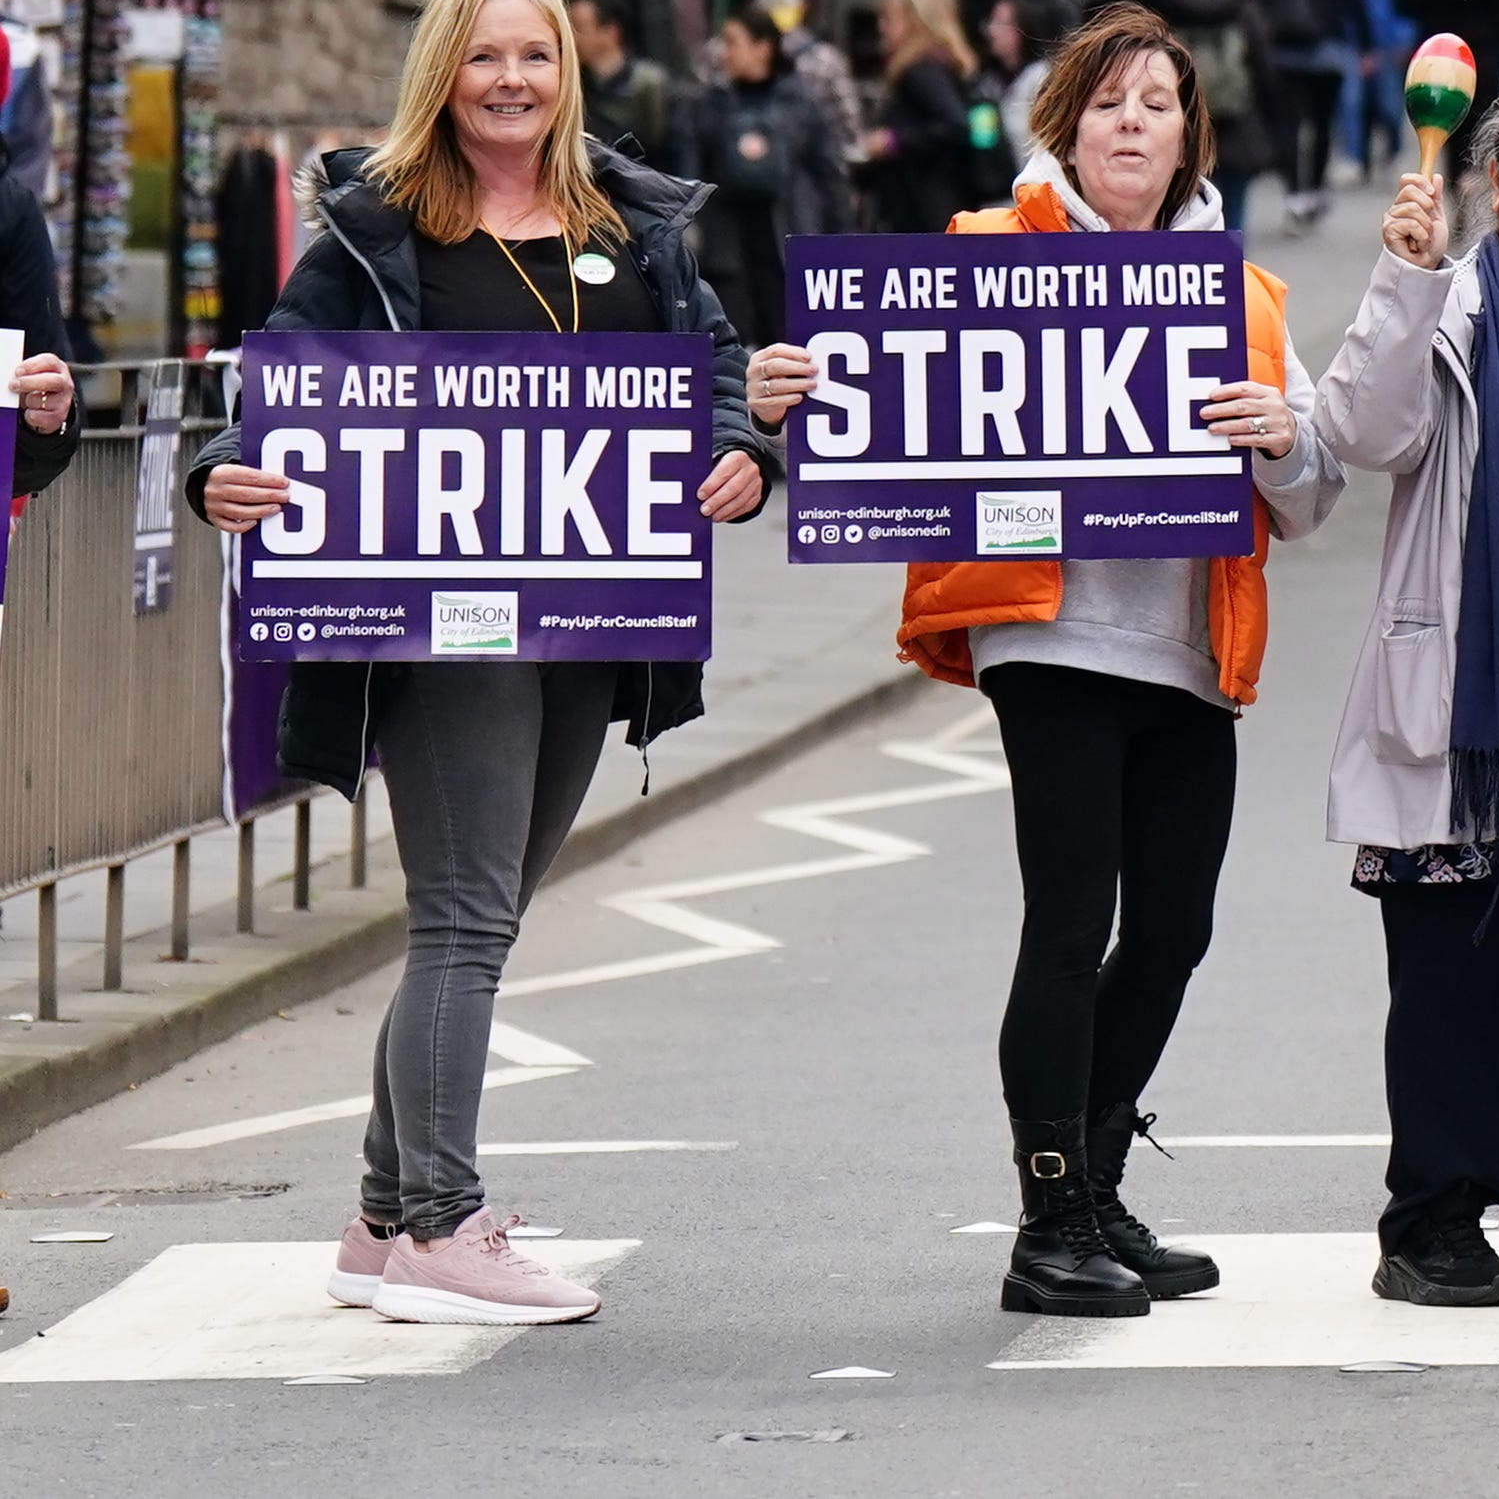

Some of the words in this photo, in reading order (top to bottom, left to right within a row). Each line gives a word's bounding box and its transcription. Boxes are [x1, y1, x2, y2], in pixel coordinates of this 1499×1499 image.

[805, 269, 863, 309] WE
[881, 268, 957, 309] ARE
[974, 265, 1107, 307] WORTH
[1123, 264, 1225, 305] MORE
[263, 366, 322, 406] WE
[339, 366, 417, 406] ARE
[435, 366, 569, 407] WORTH
[586, 367, 691, 408] MORE
[805, 326, 1231, 458] STRIKE
[261, 428, 692, 557] STRIKE
[799, 506, 950, 521] unison-edinburgh.org.uk
[985, 507, 1054, 523] UNISON
[1084, 511, 1238, 528] #PayUpForCouncilStaff
[868, 525, 950, 539] @unisonedin
[251, 605, 405, 620] unison-edinburgh.org.uk
[440, 607, 510, 623] UNISON
[321, 624, 404, 638] @unisonedin
[540, 616, 696, 630] #PayUpForCouncilStaff
